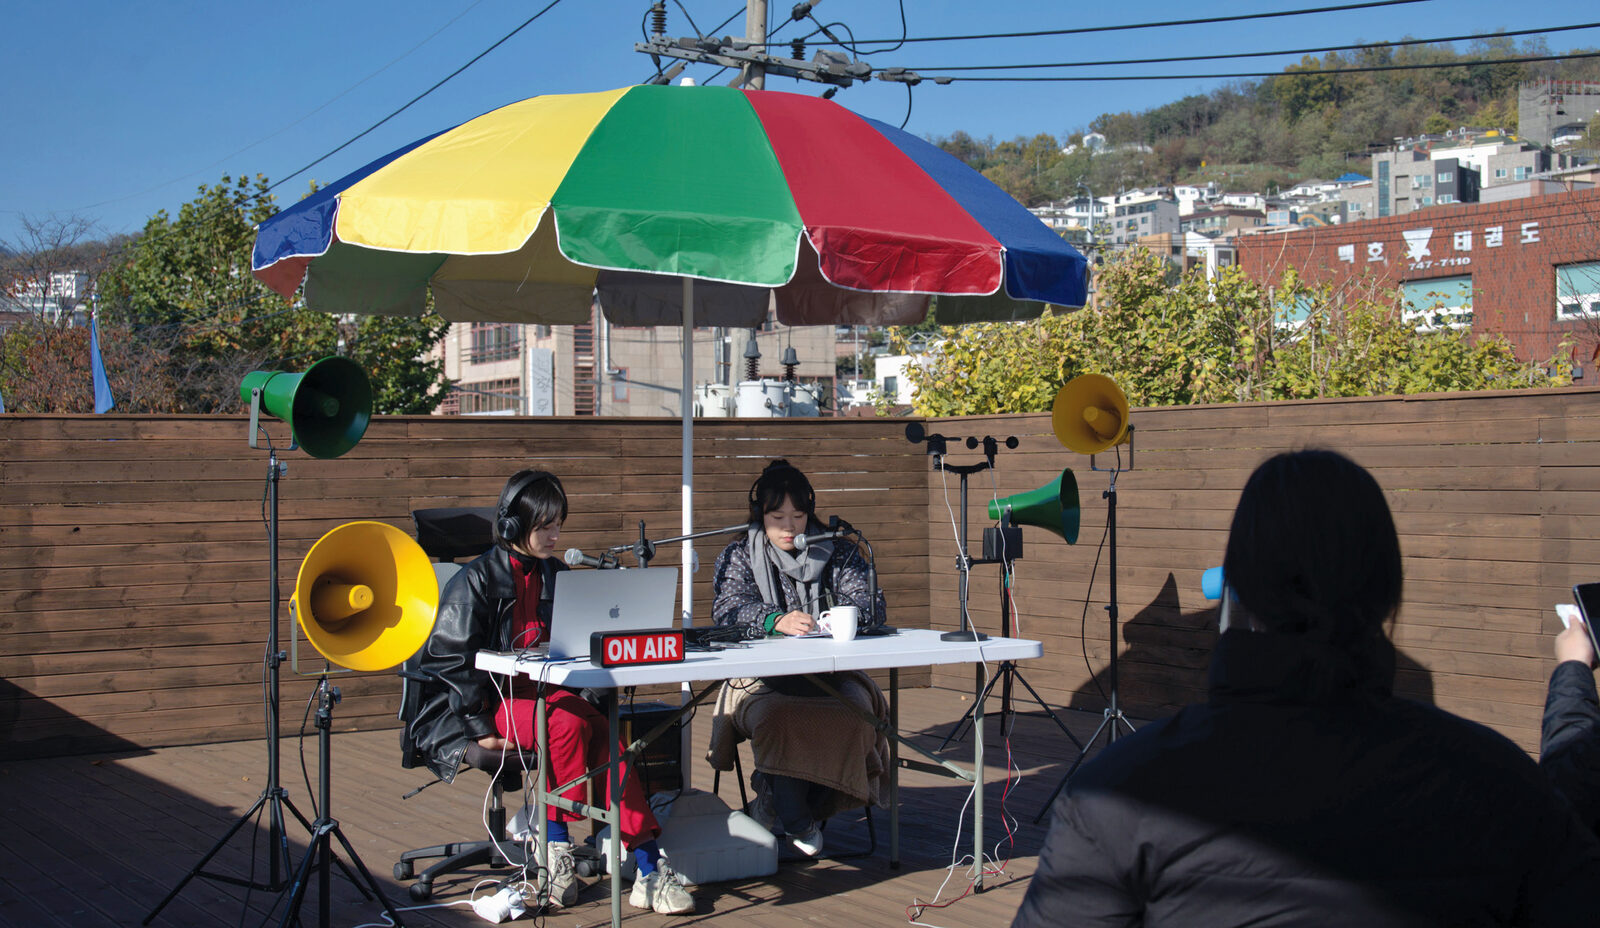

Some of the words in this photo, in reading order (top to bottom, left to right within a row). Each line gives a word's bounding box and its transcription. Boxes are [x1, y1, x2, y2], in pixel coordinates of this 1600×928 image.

[1337, 241, 1385, 264] 백호
[1453, 221, 1541, 252] 태권도
[1408, 256, 1472, 271] 747-7110
[607, 638, 638, 662] ON
[643, 636, 678, 660] AIR
